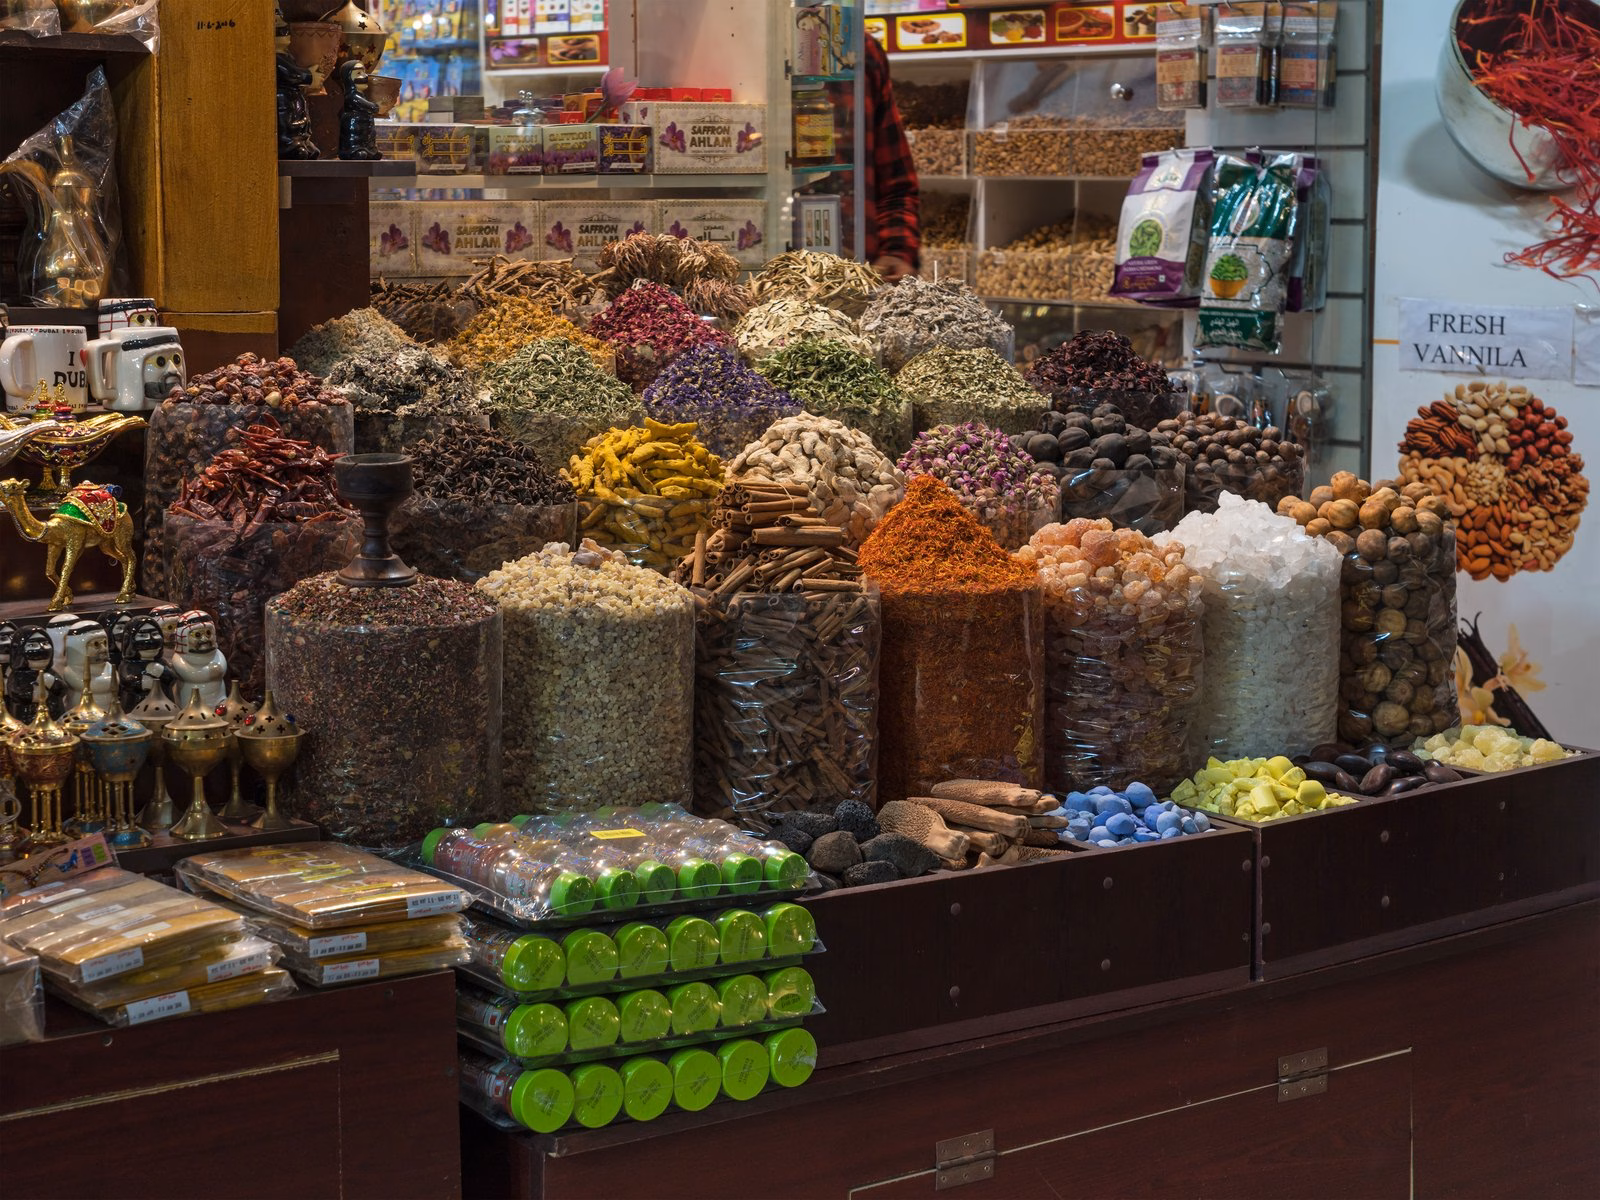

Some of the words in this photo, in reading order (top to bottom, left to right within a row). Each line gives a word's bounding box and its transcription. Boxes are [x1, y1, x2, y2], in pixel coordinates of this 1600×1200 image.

[691, 125, 730, 135] SAFFRON
[689, 136, 732, 148] AHLAM
[456, 225, 499, 236] SAFFRON
[578, 224, 618, 235] SAFFRON
[455, 237, 500, 248] AHLAM
[1428, 313, 1505, 335] FRESH
[68, 351, 75, 366] I
[1413, 343, 1528, 368] VANNILA
[53, 371, 88, 387] DUB
